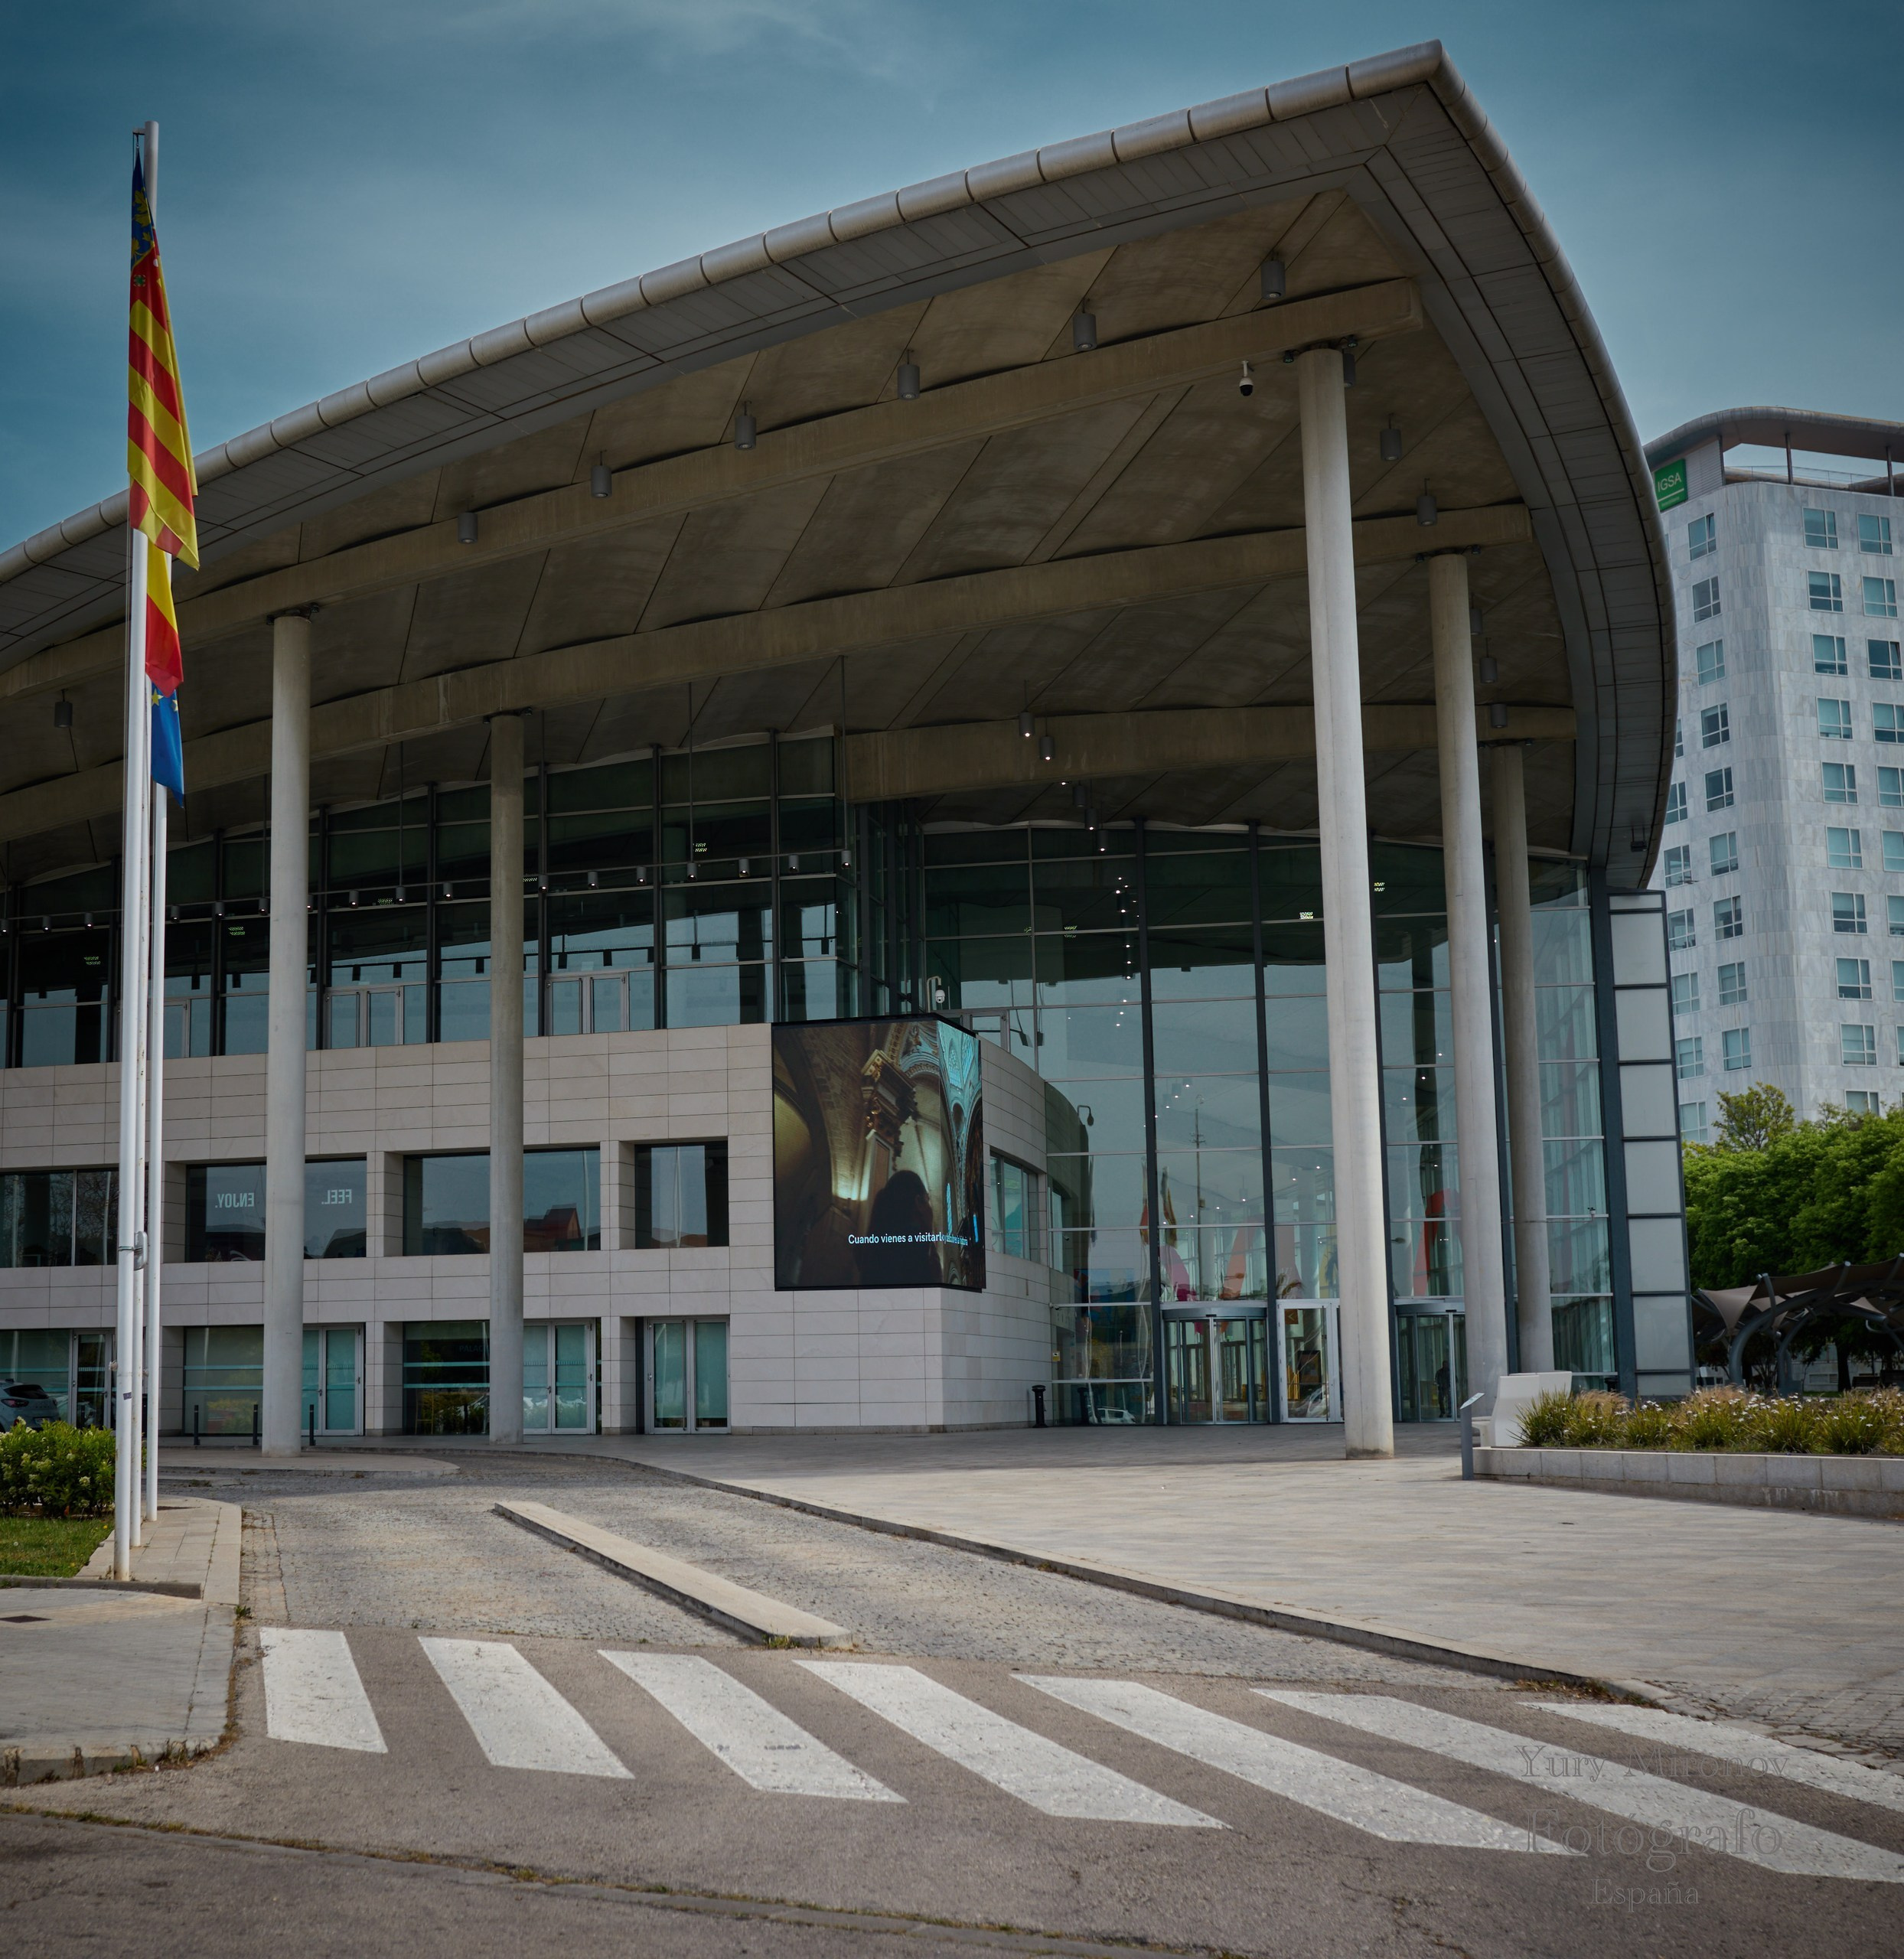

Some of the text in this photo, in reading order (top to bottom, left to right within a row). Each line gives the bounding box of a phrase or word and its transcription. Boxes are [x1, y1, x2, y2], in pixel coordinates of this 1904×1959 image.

[1658, 472, 1682, 492] IGSA
[848, 1234, 879, 1244] Cuando
[881, 1234, 906, 1244] vienes
